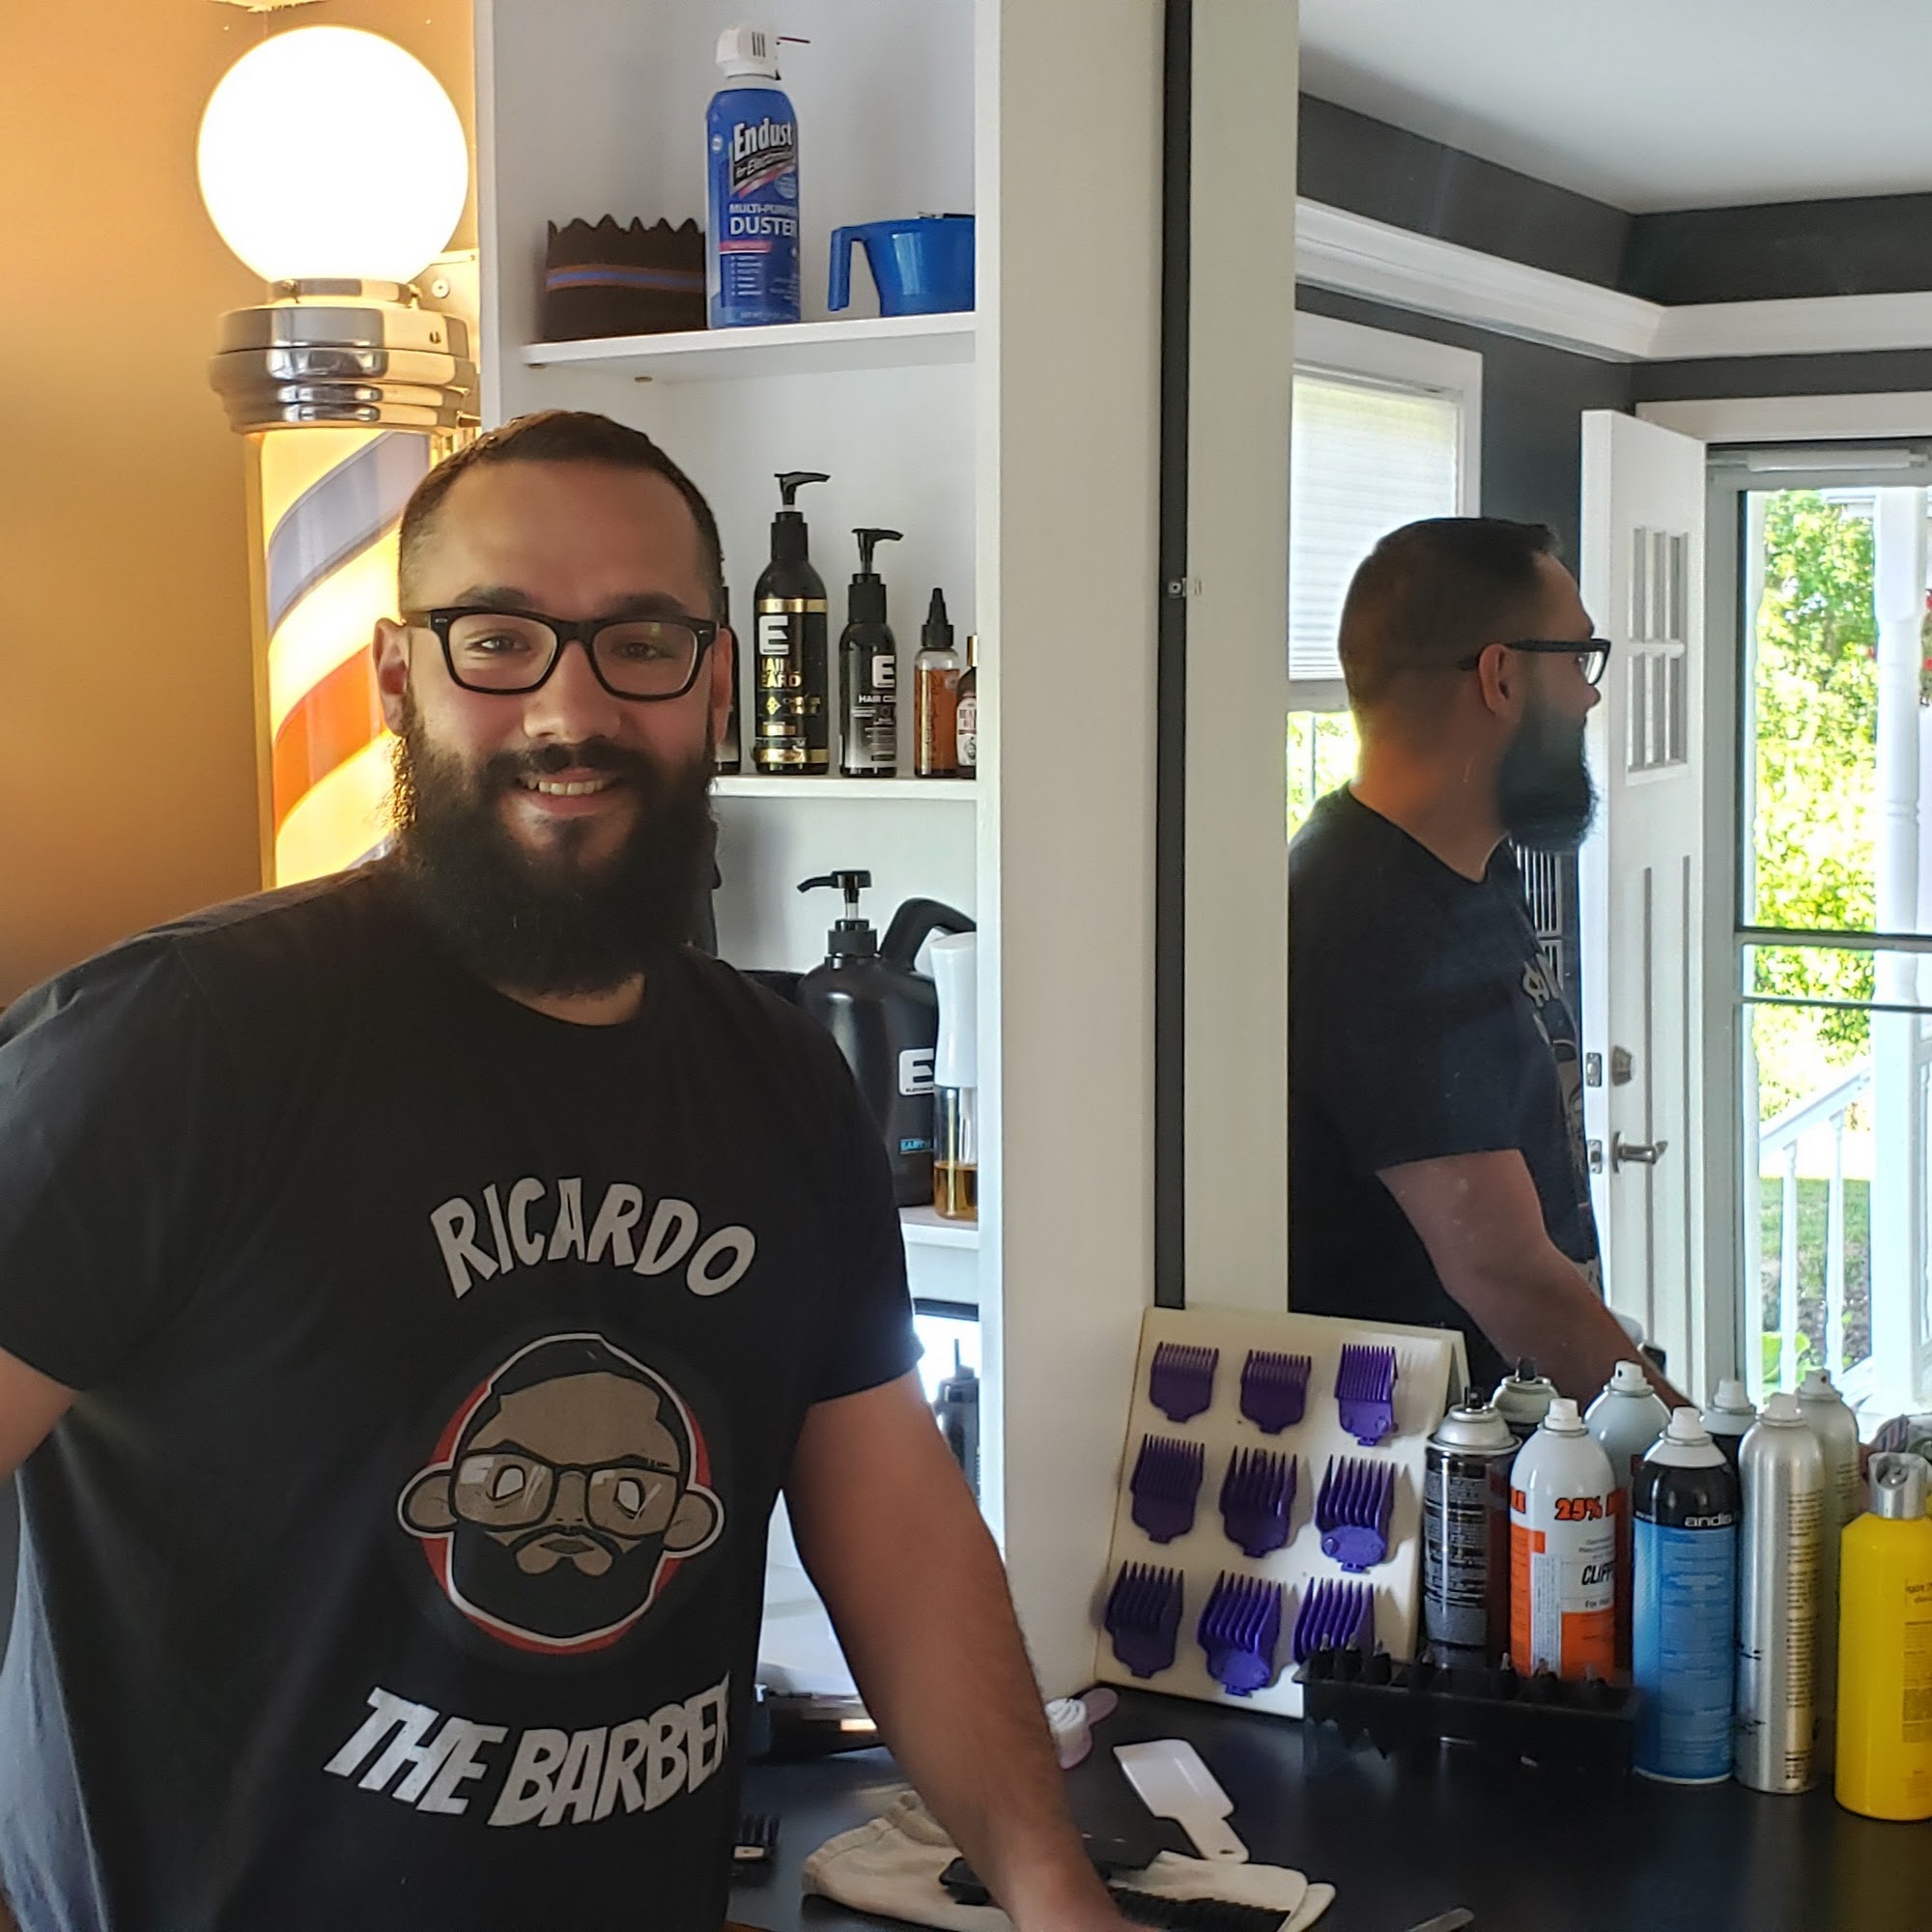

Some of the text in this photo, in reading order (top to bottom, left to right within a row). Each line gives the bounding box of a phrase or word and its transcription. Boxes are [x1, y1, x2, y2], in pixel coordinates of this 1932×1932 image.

[733, 117, 792, 162] Endust
[429, 1177, 755, 1299] RICARDO
[1554, 1495, 1603, 1521] 25%
[324, 1686, 508, 1815] THE
